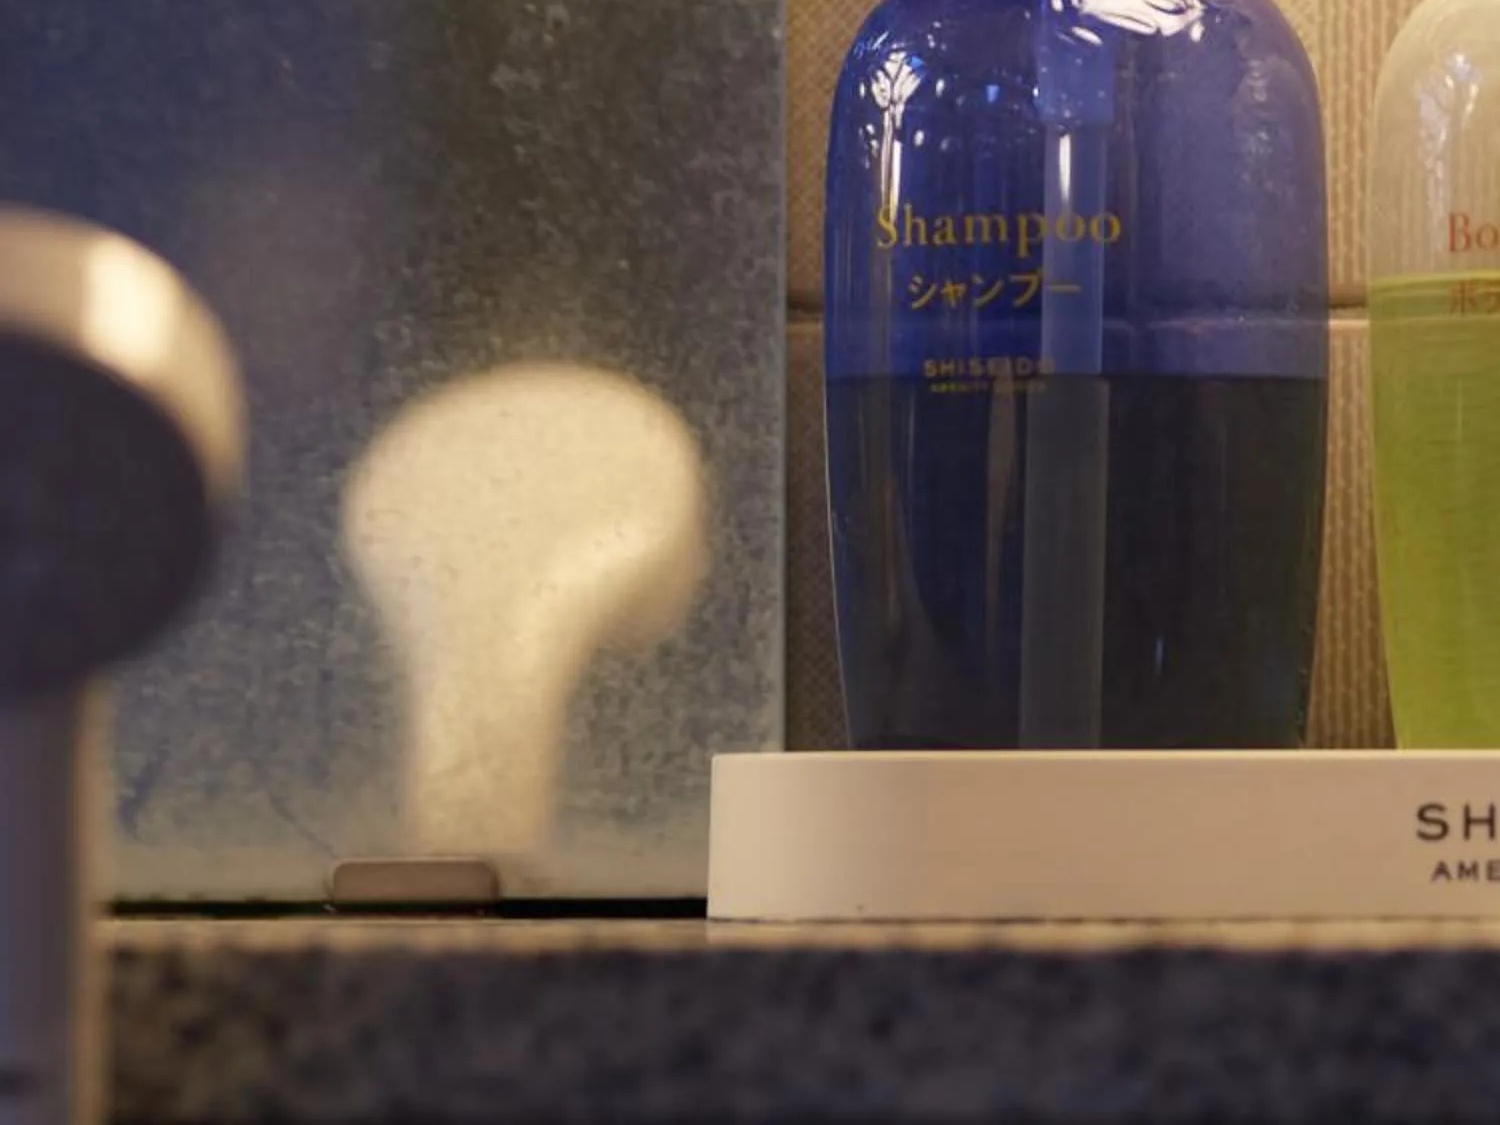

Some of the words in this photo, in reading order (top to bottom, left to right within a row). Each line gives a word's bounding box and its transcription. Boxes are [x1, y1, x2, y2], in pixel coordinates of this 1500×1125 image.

[876, 202, 1122, 259] Shampoo
[907, 267, 1083, 310] シャンプー
[922, 356, 1056, 378] SHISEDO
